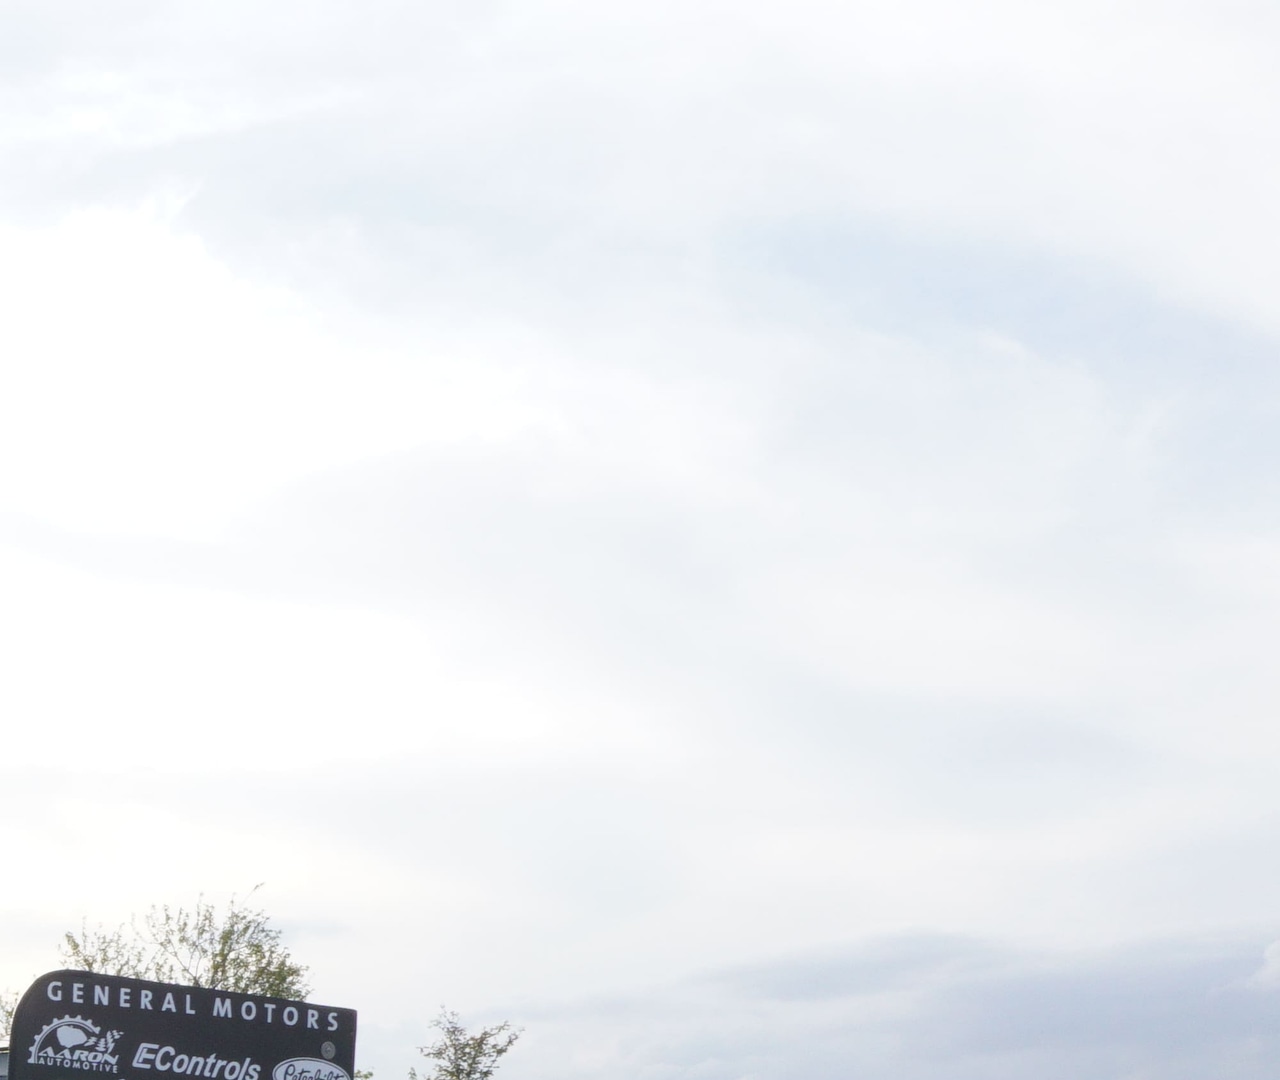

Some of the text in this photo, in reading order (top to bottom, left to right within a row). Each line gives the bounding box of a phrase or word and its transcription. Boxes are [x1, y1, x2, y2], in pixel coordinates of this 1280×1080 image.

[47, 981, 339, 1031] GENERAL MOTORS
[38, 1046, 119, 1065] AARON
[38, 1057, 119, 1074] AUTOMOTIVE
